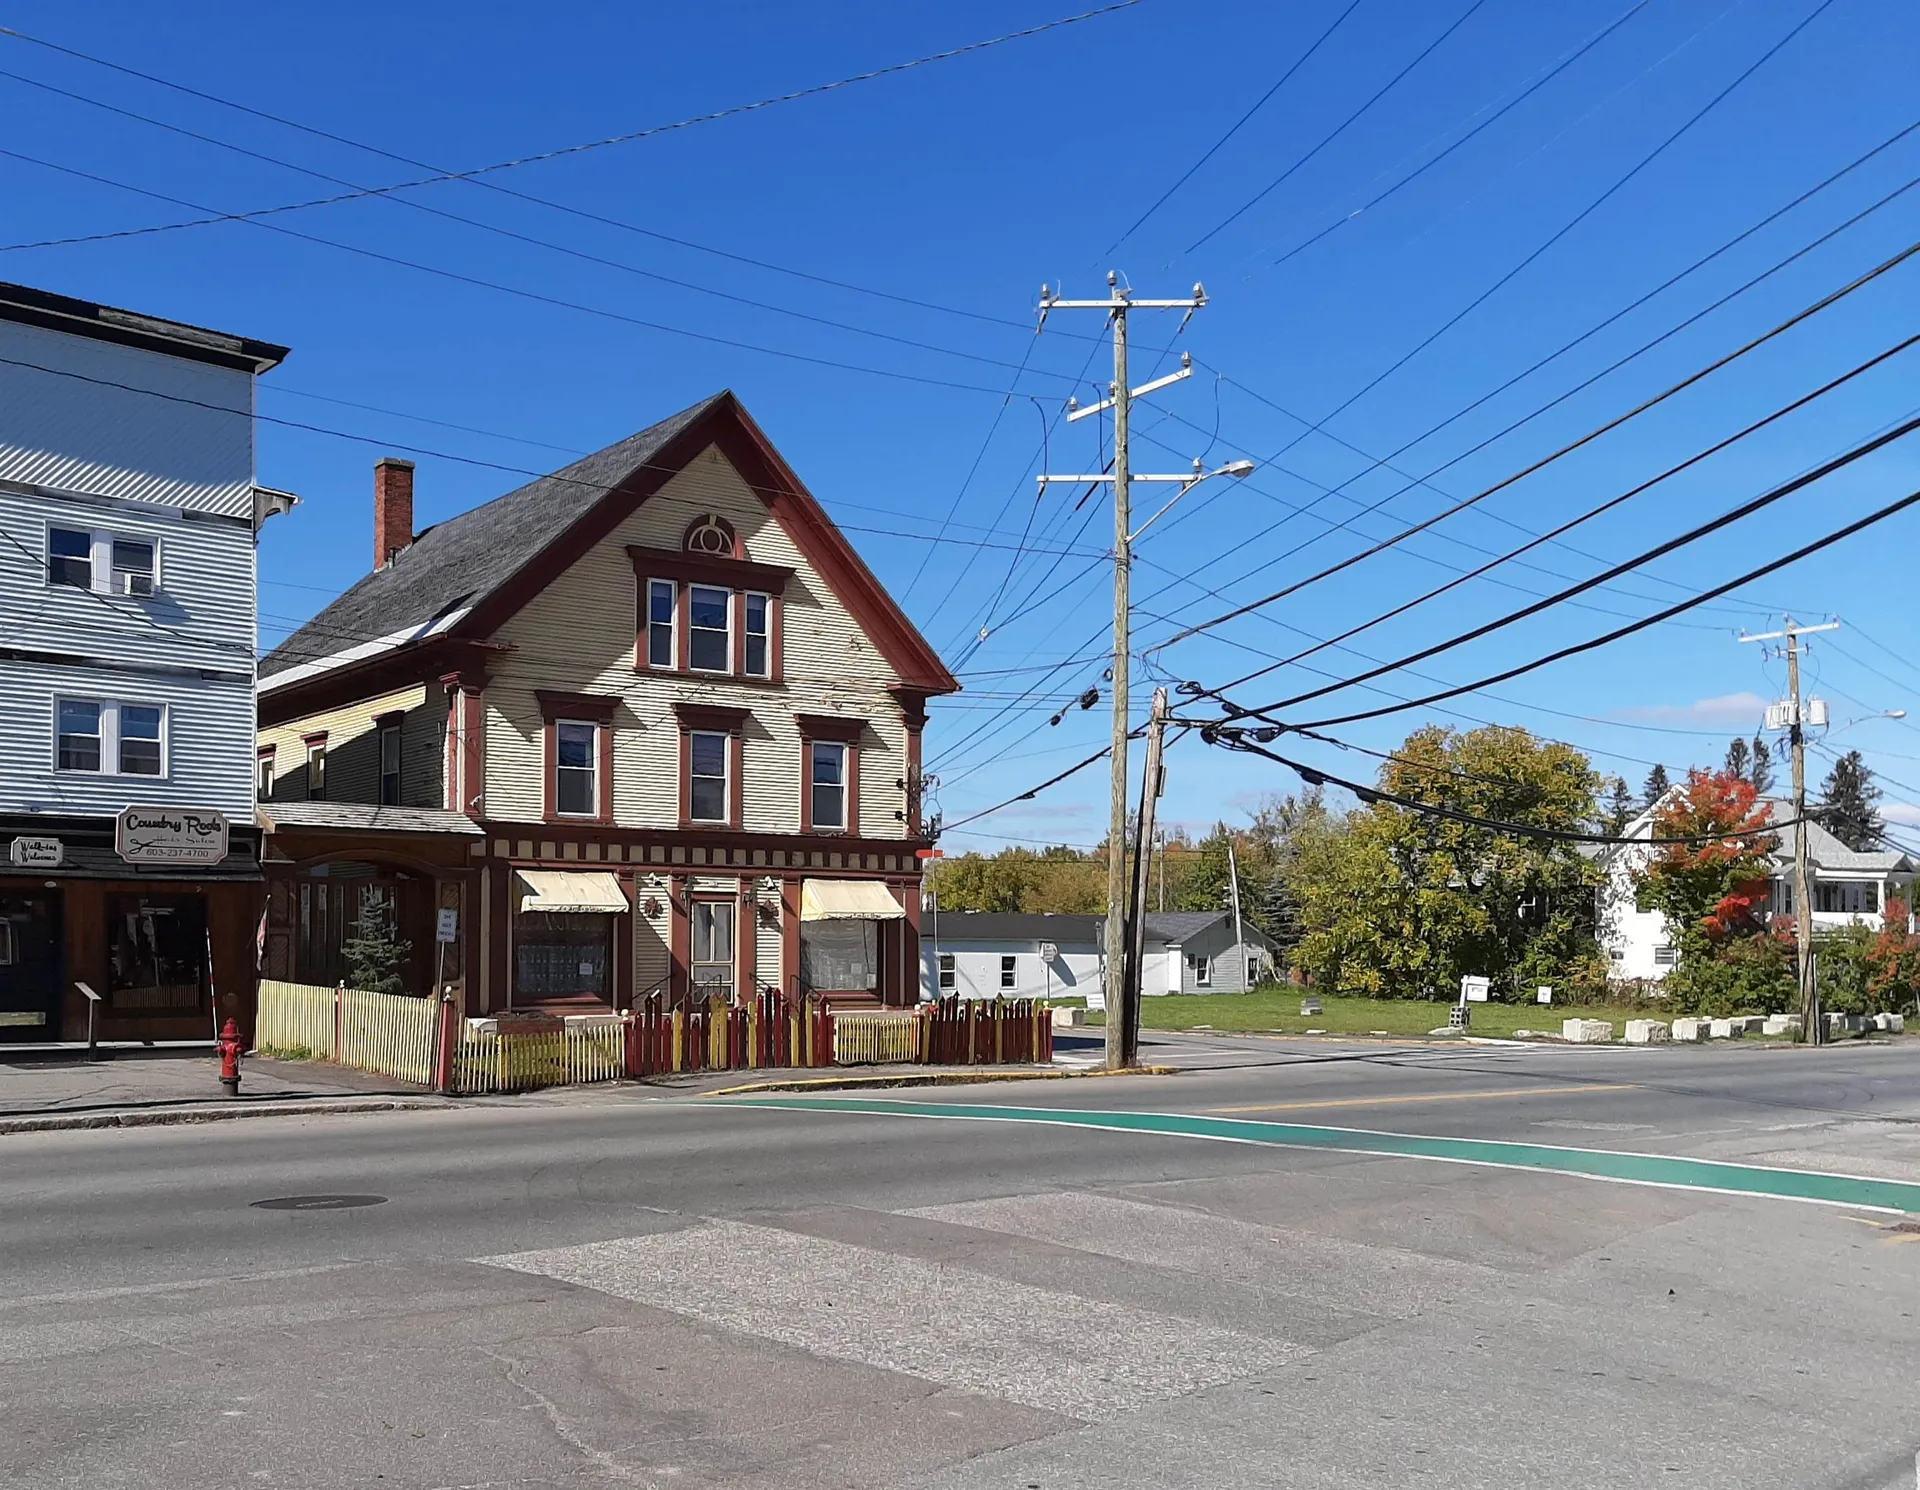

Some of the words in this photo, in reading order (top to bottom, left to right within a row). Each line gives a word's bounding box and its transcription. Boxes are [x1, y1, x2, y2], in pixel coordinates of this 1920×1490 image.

[126, 814, 182, 833] Country
[182, 815, 221, 836] Roots
[146, 848, 209, 858] 603-237-4700
